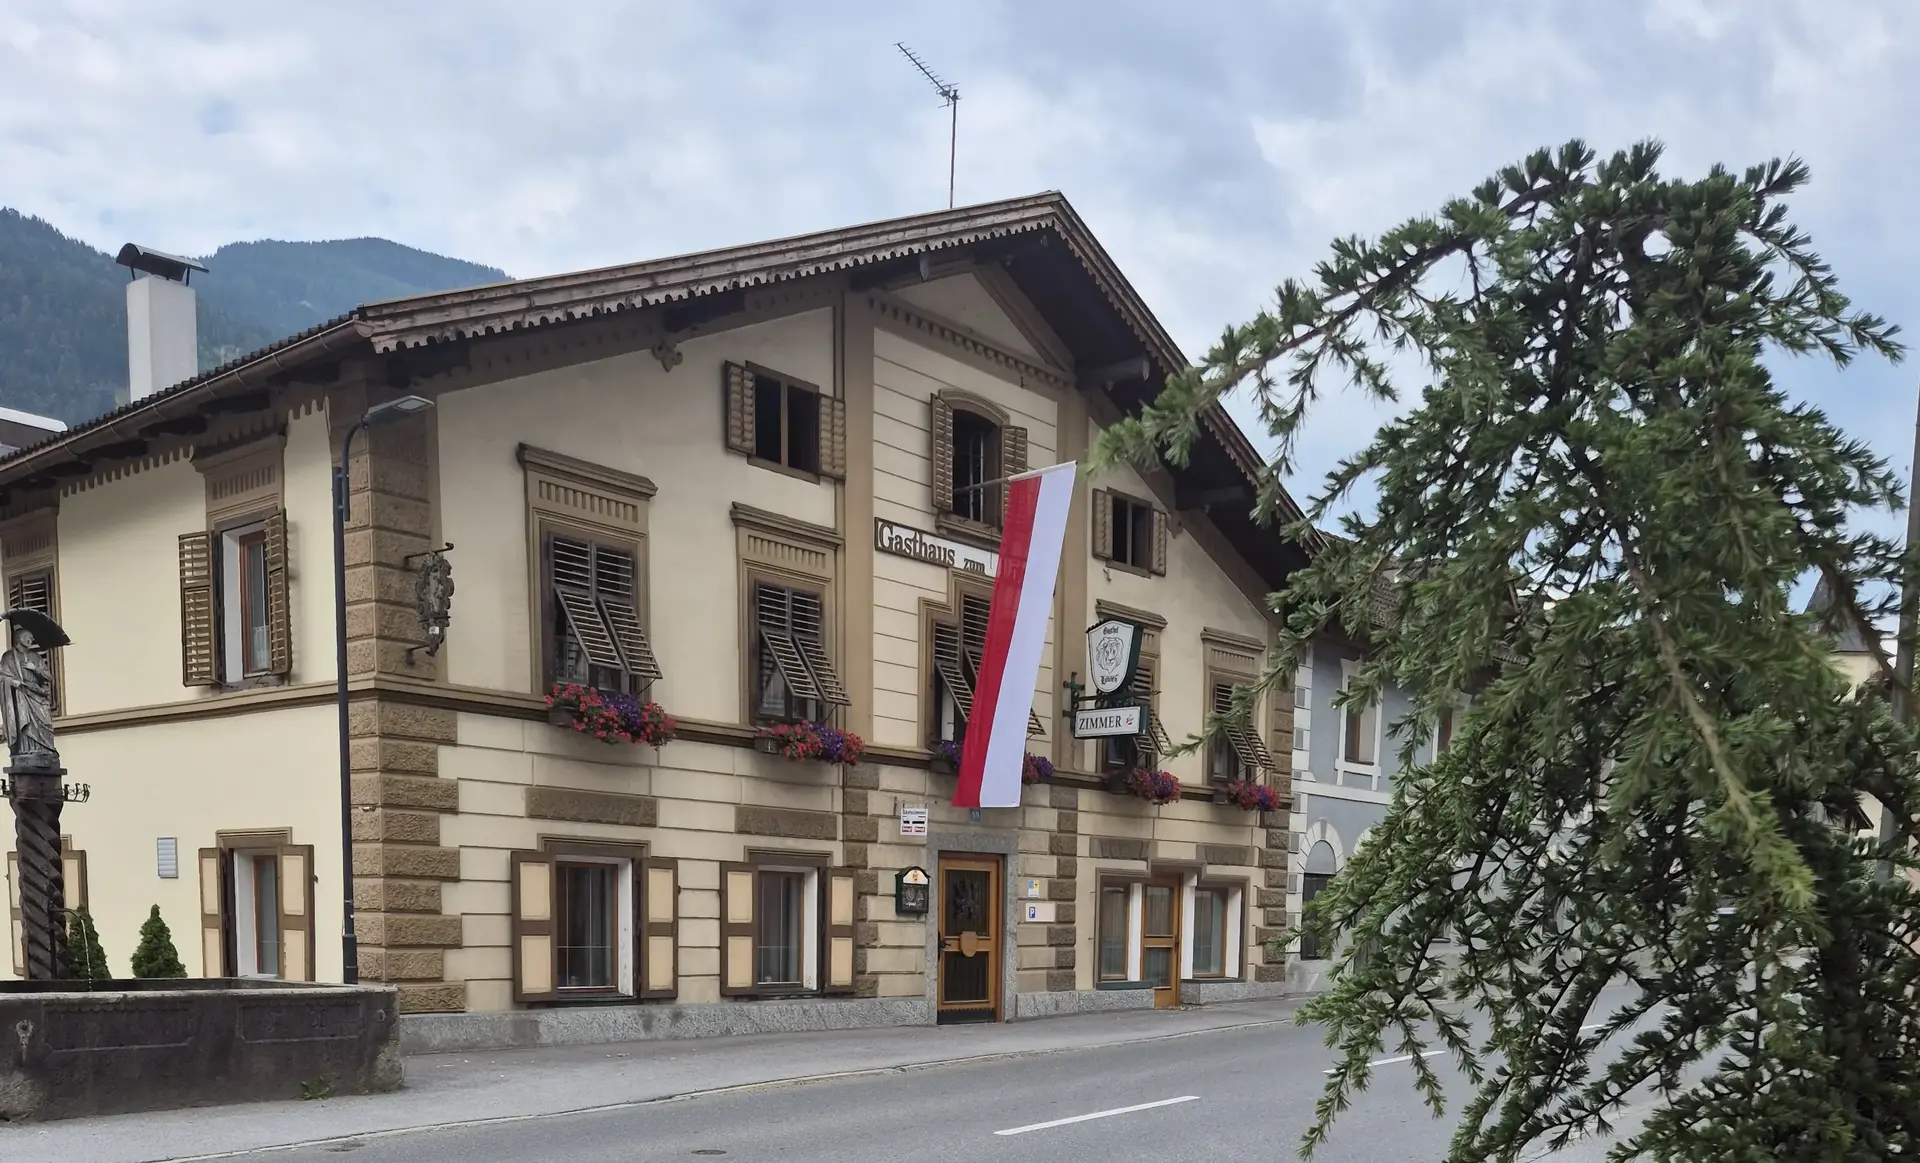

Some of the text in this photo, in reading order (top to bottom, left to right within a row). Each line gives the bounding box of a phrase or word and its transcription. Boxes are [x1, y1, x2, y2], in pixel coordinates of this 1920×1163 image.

[879, 521, 956, 567] Gasthaus
[963, 558, 986, 573] zum
[1079, 715, 1122, 730] ZIMMER
